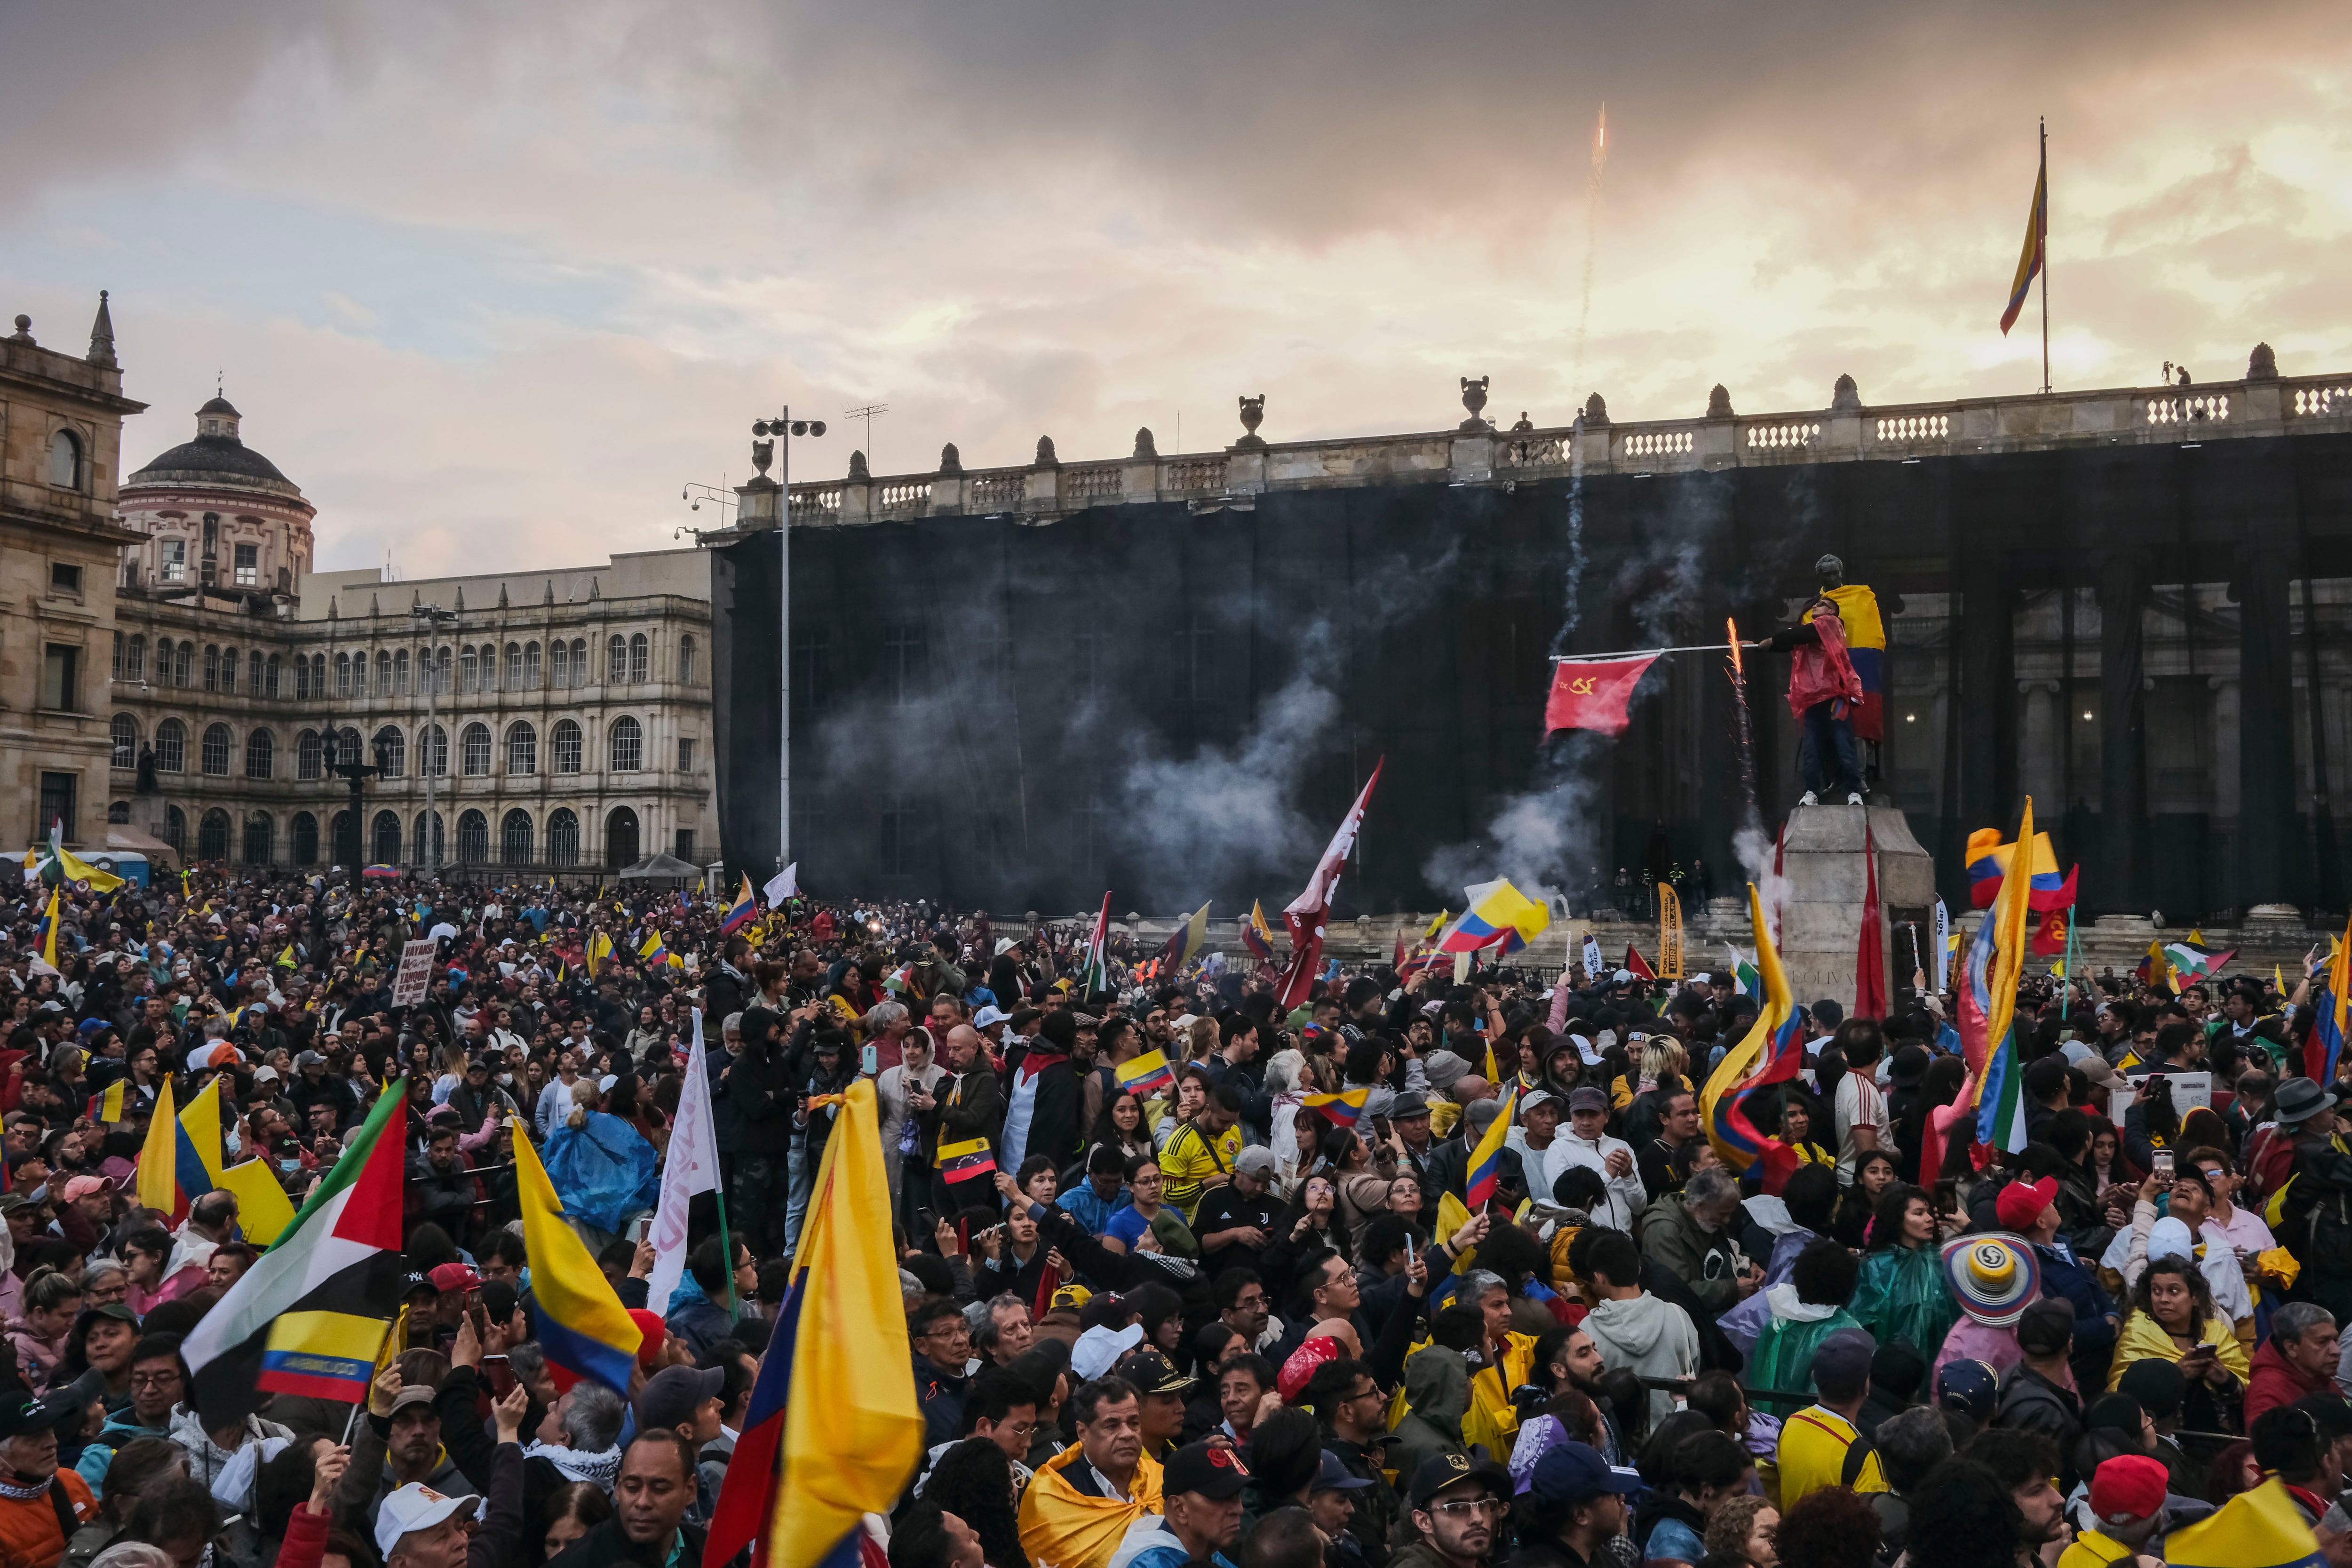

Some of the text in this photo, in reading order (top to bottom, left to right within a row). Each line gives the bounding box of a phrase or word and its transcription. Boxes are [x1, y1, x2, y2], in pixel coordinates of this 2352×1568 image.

[405, 943, 435, 957] VÁYANSE
[400, 970, 429, 984] YANQUIS
[1792, 971, 1857, 985] BOLIVA
